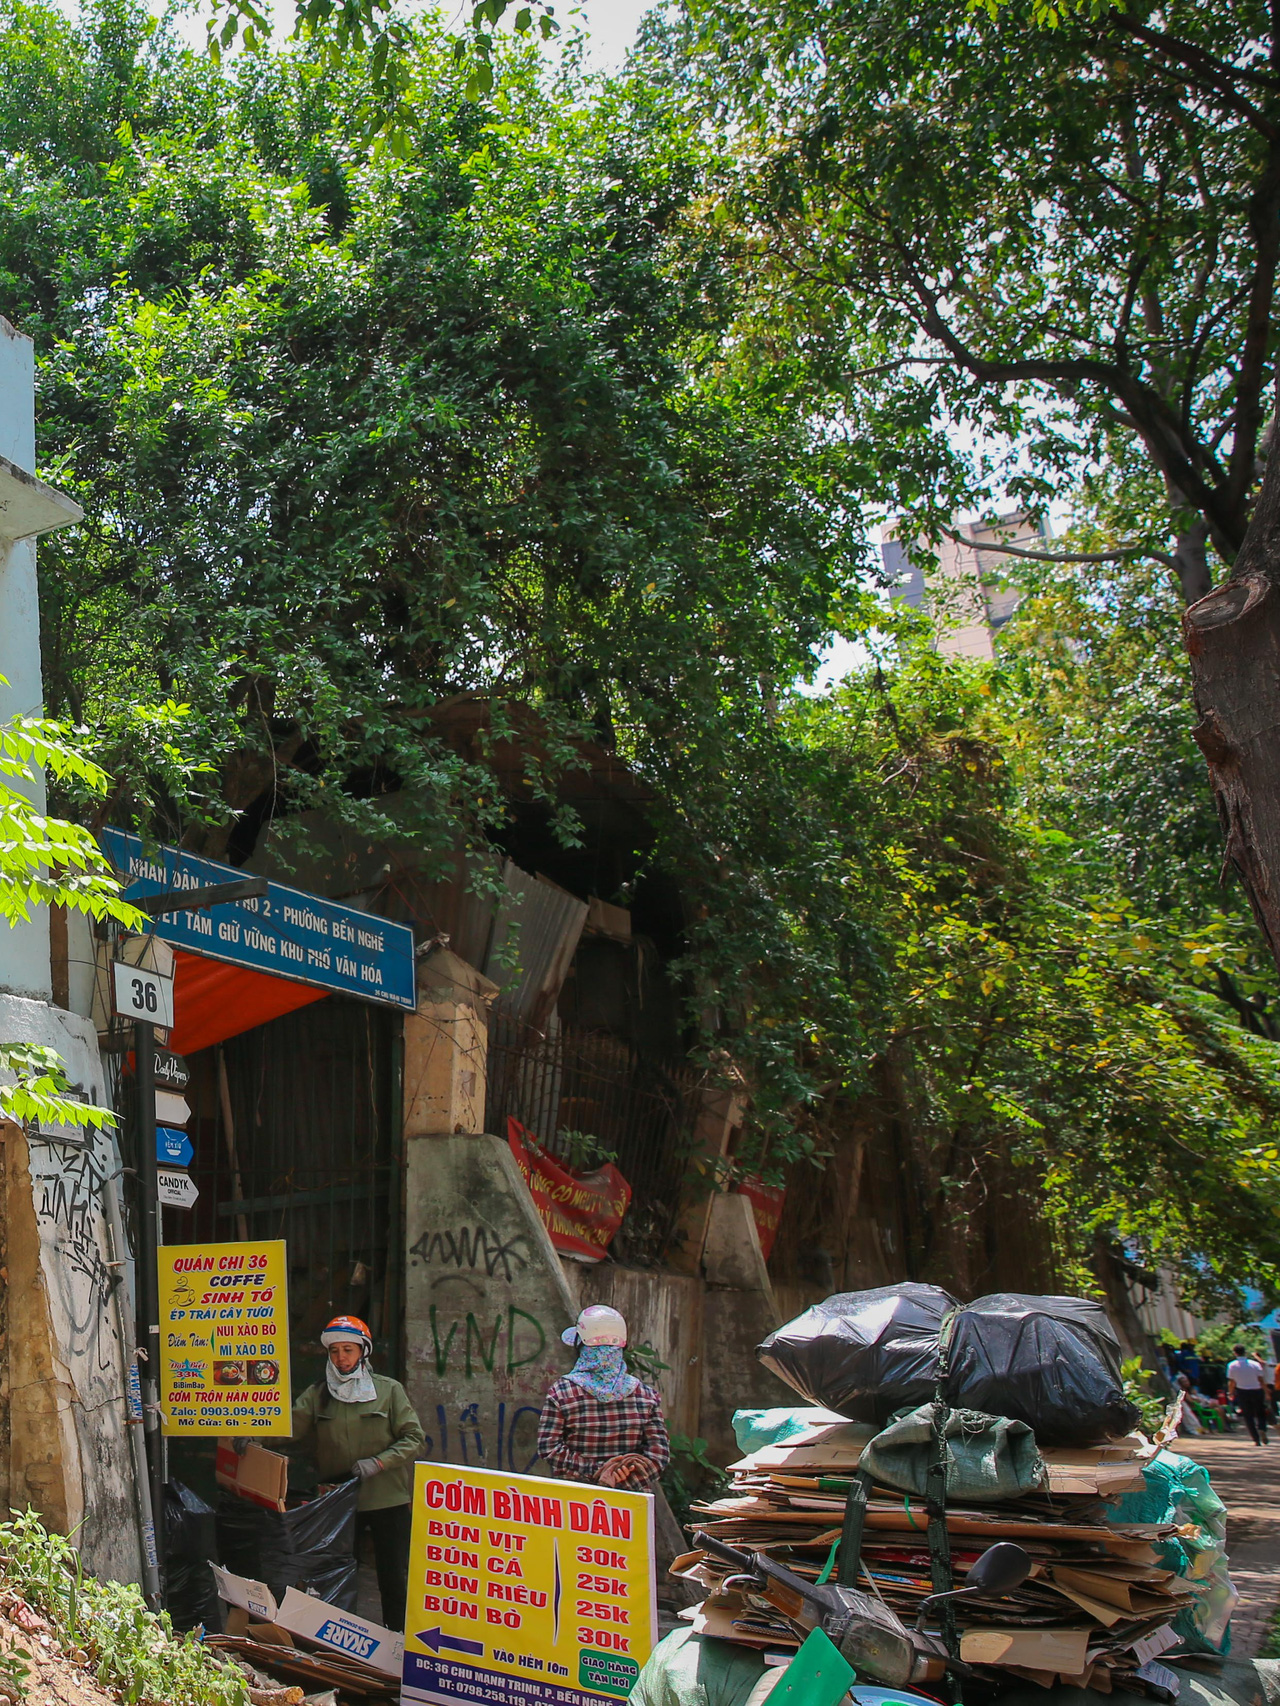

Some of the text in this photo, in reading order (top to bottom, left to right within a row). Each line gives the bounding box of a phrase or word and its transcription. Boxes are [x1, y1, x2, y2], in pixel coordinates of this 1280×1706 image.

[263, 900, 272, 917] 2
[283, 905, 328, 935] PHƯỜNG
[332, 917, 355, 943] BẾN
[358, 931, 385, 953] NGHÉ
[218, 919, 240, 943] GIỮ
[243, 926, 276, 955] VỮNG
[280, 939, 304, 962] KHU
[307, 947, 332, 970] PHỐ
[335, 955, 357, 978] VĂN
[361, 963, 383, 985] HÓA
[131, 978, 157, 1012] 36
[159, 1176, 189, 1190] CANDYK
[173, 1254, 268, 1273] QUÁN CHI 36
[210, 1274, 265, 1287] COFFE
[200, 1286, 276, 1304] SINH TỐ
[170, 1306, 274, 1320] ÉP TRÁI CÂY TƯƠI
[217, 1321, 276, 1337] NUI XÀO BÒ
[220, 1341, 274, 1356] MÌ XÀO BÒ
[168, 1387, 280, 1404] CƠM TRỘN HÀN QUỐC
[173, 1382, 205, 1390] BiBimBap
[171, 1407, 281, 1416] Zalo: 0903.094.979
[425, 1479, 632, 1540] CƠM BÌNH DÂN
[428, 1520, 526, 1553] BÚN VỊT
[427, 1545, 523, 1578] BÚN CÁ
[576, 1546, 627, 1570] 30k
[425, 1569, 548, 1609] BÚN RIÊU
[577, 1573, 629, 1598] 25k
[424, 1594, 521, 1630] BÚN BÒ
[576, 1600, 630, 1625] 25k
[323, 1622, 374, 1656] SKARE
[577, 1626, 630, 1653] 30k
[493, 1648, 515, 1664] VÀO
[518, 1652, 543, 1671] HẺM
[582, 1656, 637, 1675] GIAO HÀNG
[416, 1658, 433, 1671] ĐC:
[435, 1663, 449, 1674] 36
[451, 1666, 472, 1679] CHU
[474, 1671, 505, 1687] MẠNH
[507, 1679, 543, 1697] TRINH,
[544, 1688, 555, 1699] P.
[557, 1690, 580, 1705] BẾN
[588, 1671, 629, 1688] TẬN NƠI
[438, 1678, 525, 1706] ĐT: 0798.258.119
